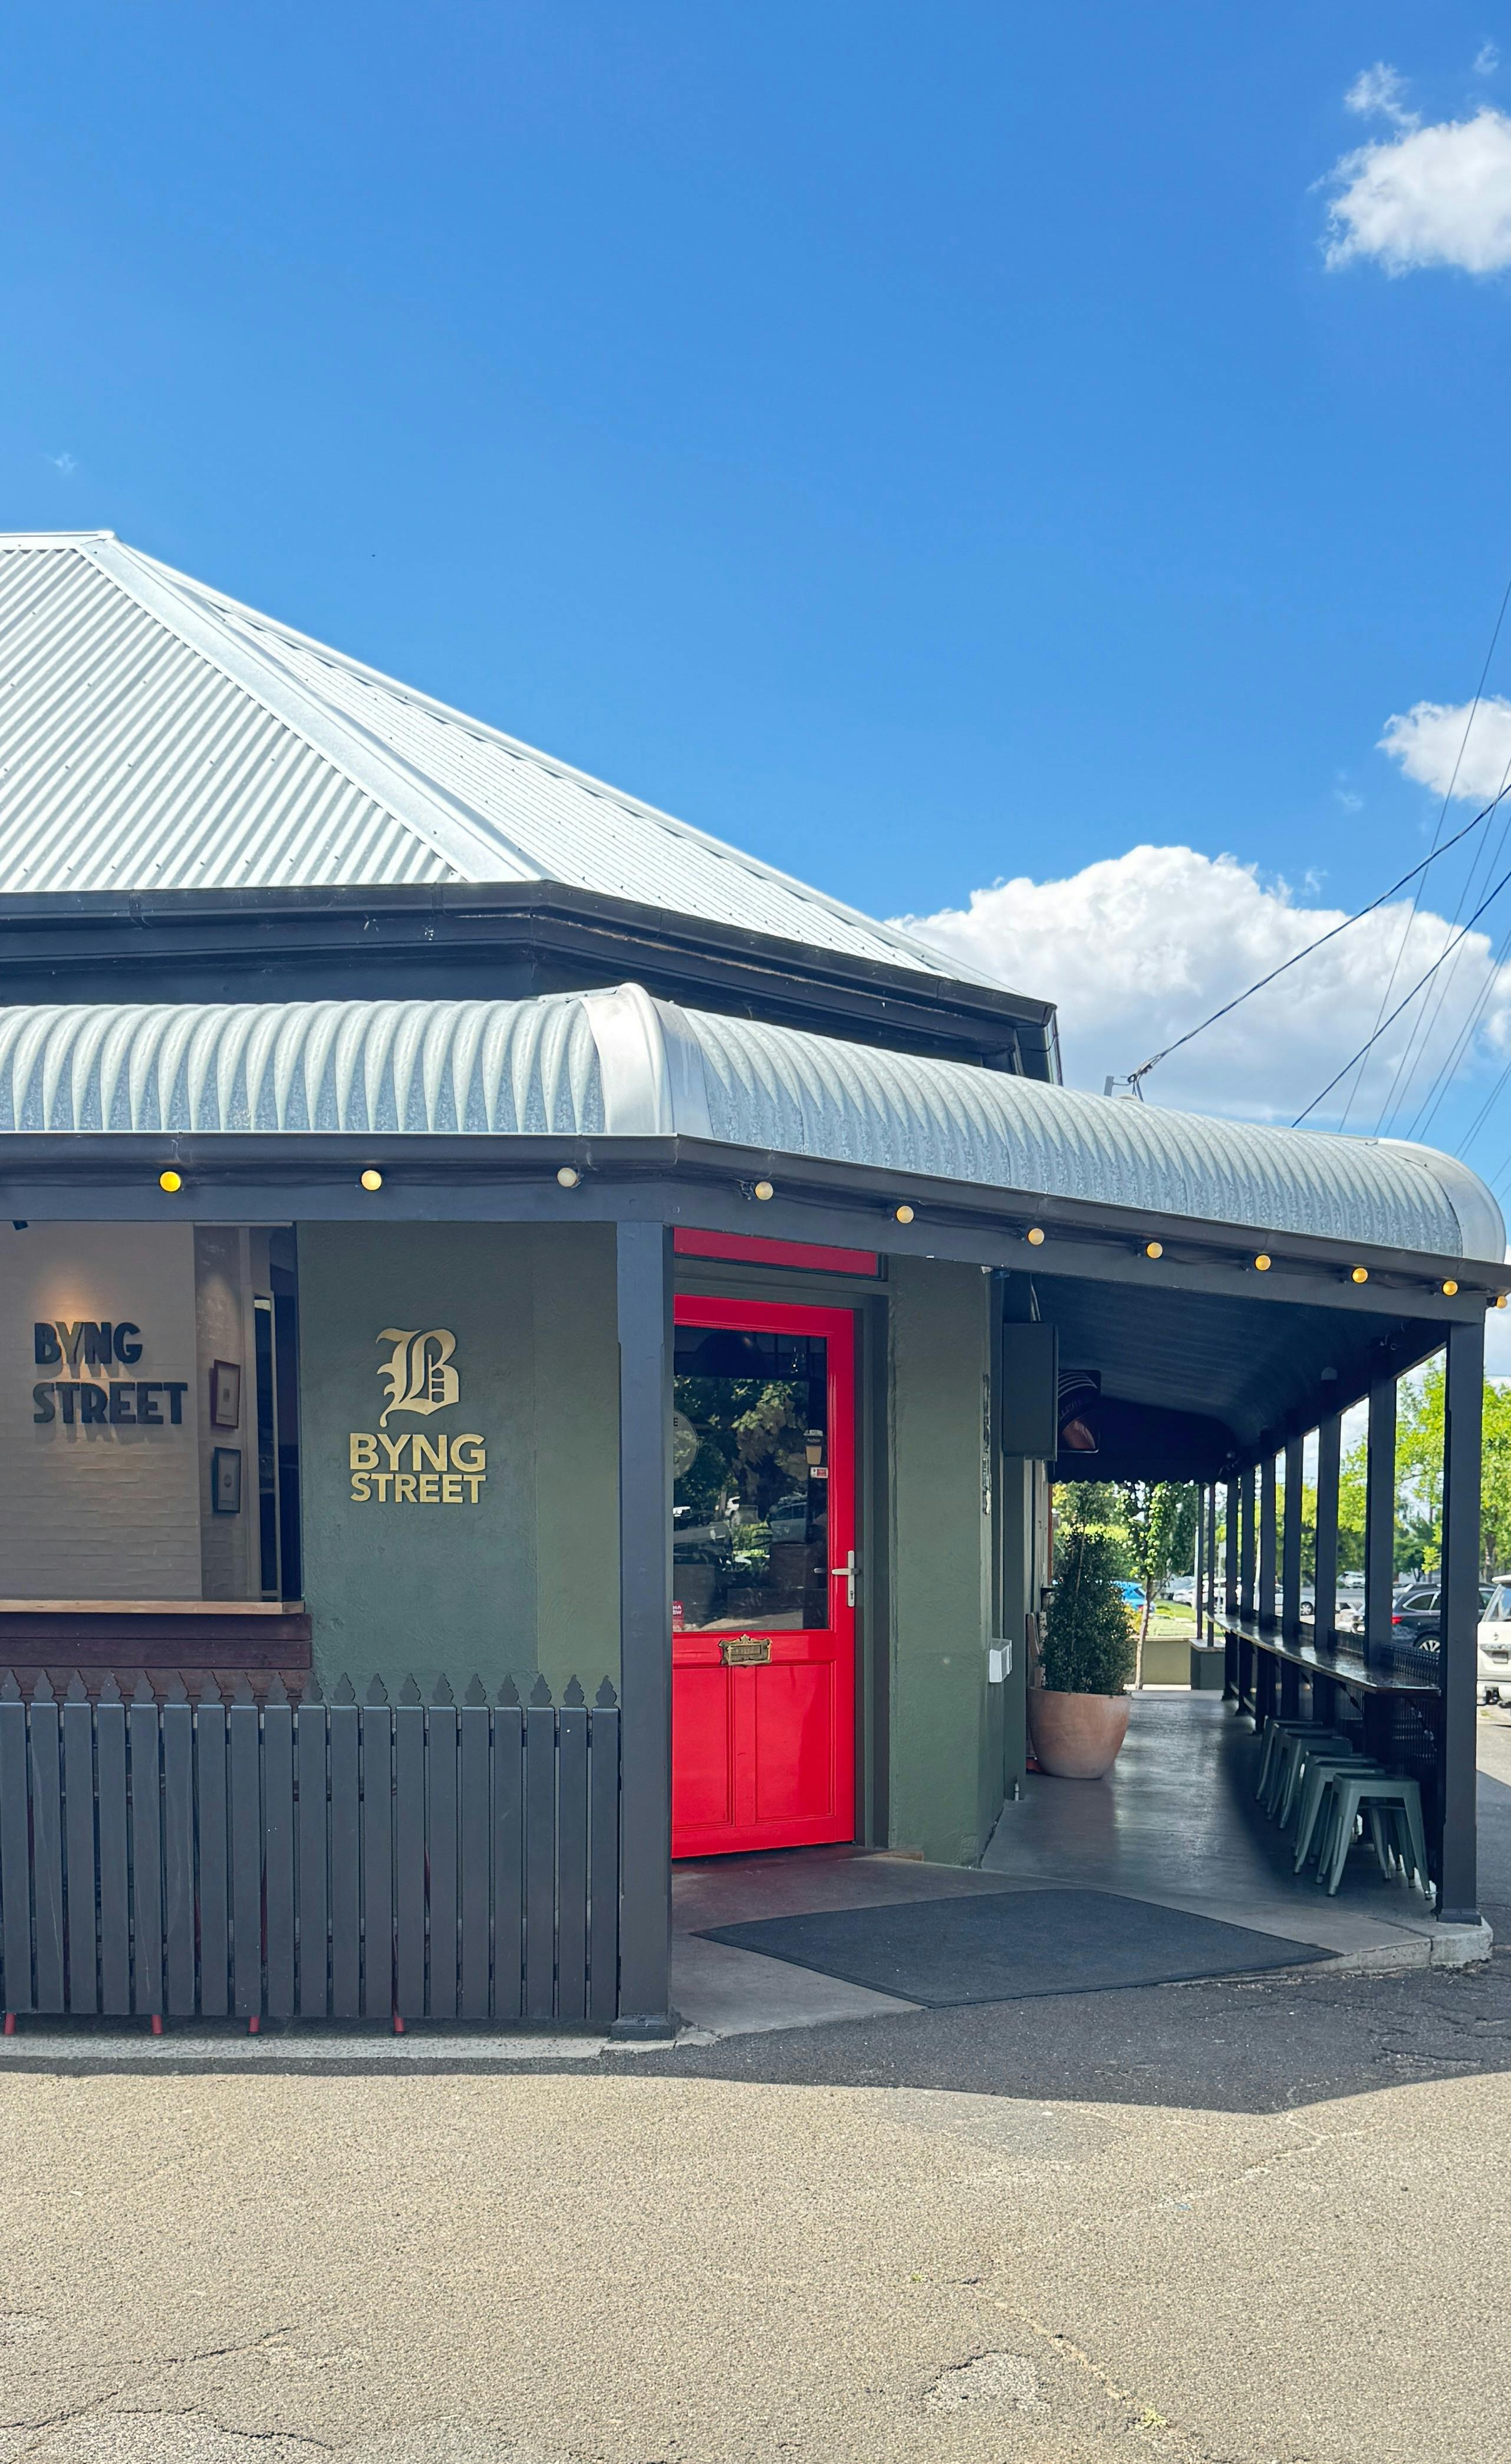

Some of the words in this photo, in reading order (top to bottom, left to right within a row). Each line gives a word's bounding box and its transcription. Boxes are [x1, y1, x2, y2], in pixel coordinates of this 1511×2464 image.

[34, 1322, 143, 1364] BYNG
[376, 1327, 459, 1428] B
[32, 1381, 188, 1424] STREET
[350, 1433, 486, 1472] BYNG
[350, 1472, 486, 1503] STREET
